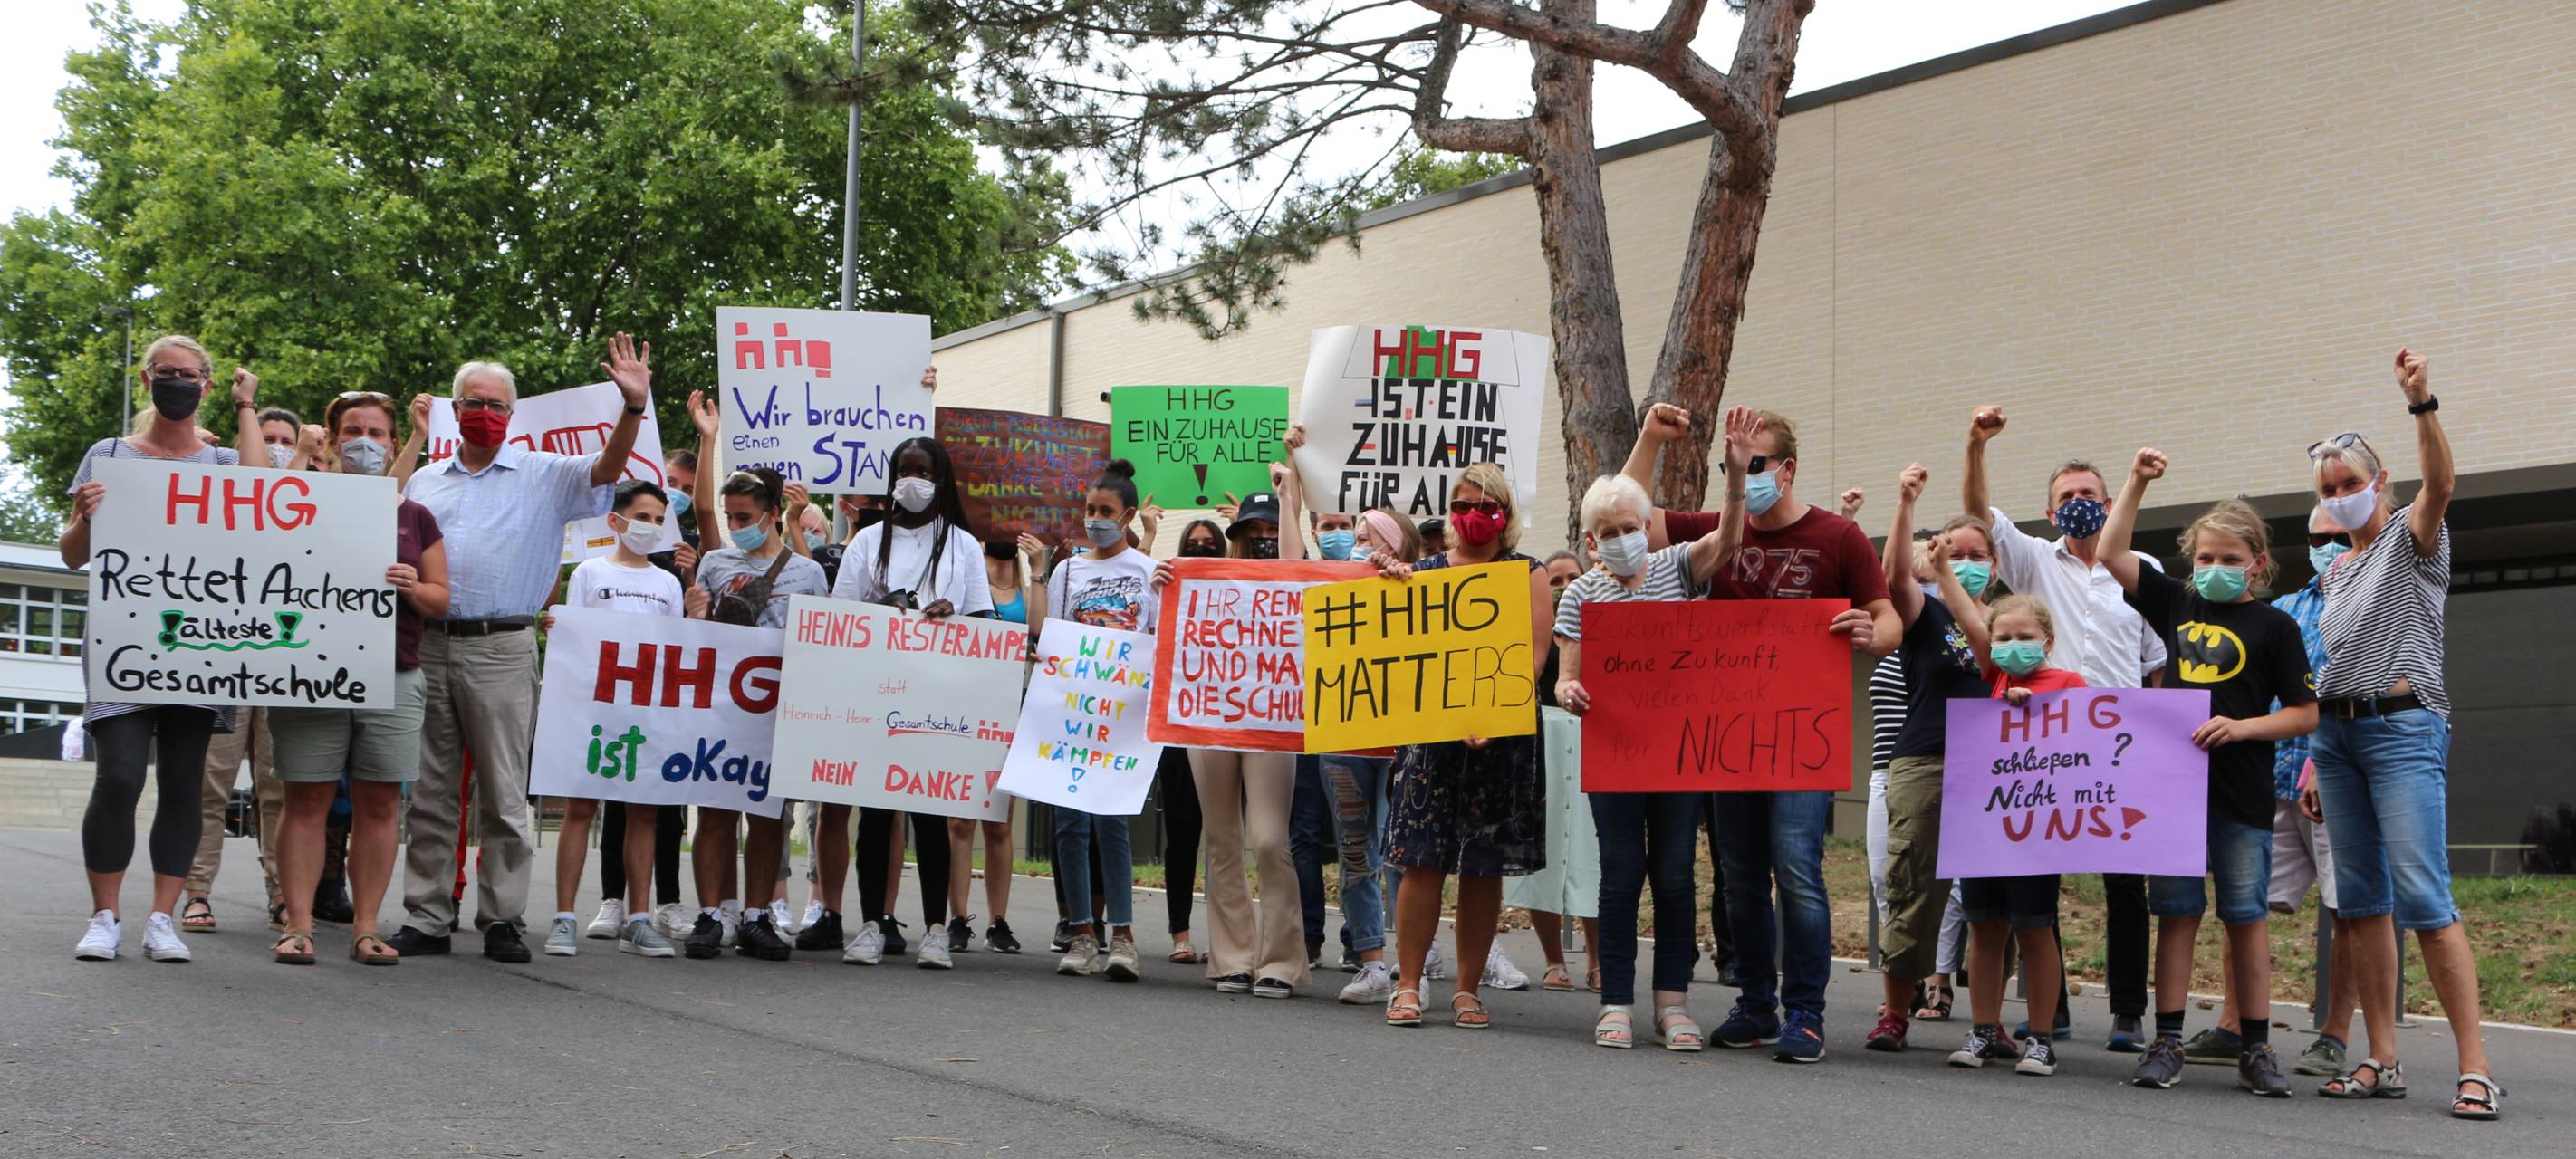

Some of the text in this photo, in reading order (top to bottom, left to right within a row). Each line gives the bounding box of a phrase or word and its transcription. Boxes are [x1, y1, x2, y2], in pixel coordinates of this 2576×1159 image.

[1373, 329, 1482, 379] HHG
[733, 381, 925, 431] Wir brauchen
[1167, 388, 1235, 411] HHG
[732, 433, 780, 451] einen
[1128, 417, 1287, 442] EIN ZUHAUSE
[1346, 422, 1507, 472] ZUHAUSE
[812, 431, 890, 487] STAN
[1157, 439, 1272, 464] FÜR ALLE
[166, 473, 317, 532] HHG
[1338, 471, 1400, 514] FÜR
[95, 548, 396, 618] Rettet Aachens
[1731, 546, 1821, 599] 1975
[598, 587, 668, 605] Champion
[1187, 589, 1304, 618] IHR REN
[797, 608, 1029, 662] HEINIS RESTERAMPE
[1079, 635, 1132, 663] WIR
[1182, 618, 1304, 649] RECHNE
[105, 644, 366, 704] Gesamtschule
[593, 639, 783, 714] HHG
[1181, 649, 1304, 686] UND MA
[1604, 650, 1657, 675] ohne
[1178, 683, 1221, 718] DIE
[1314, 642, 1533, 726] MATTERS
[1629, 675, 1771, 710] vielen Dank
[886, 710, 972, 735] Gesamtschule
[1063, 692, 1129, 721] NICHT
[1999, 694, 2122, 743] HHG
[1063, 718, 1110, 743] WIR
[1610, 706, 1841, 779] für NICHTS
[586, 724, 647, 783] ist
[1036, 740, 1139, 771] KÄMPFEN
[1991, 746, 2091, 776] schließen
[811, 758, 858, 787] NEIN
[884, 763, 975, 802] DANKE
[1985, 779, 2116, 813] Nicht mit
